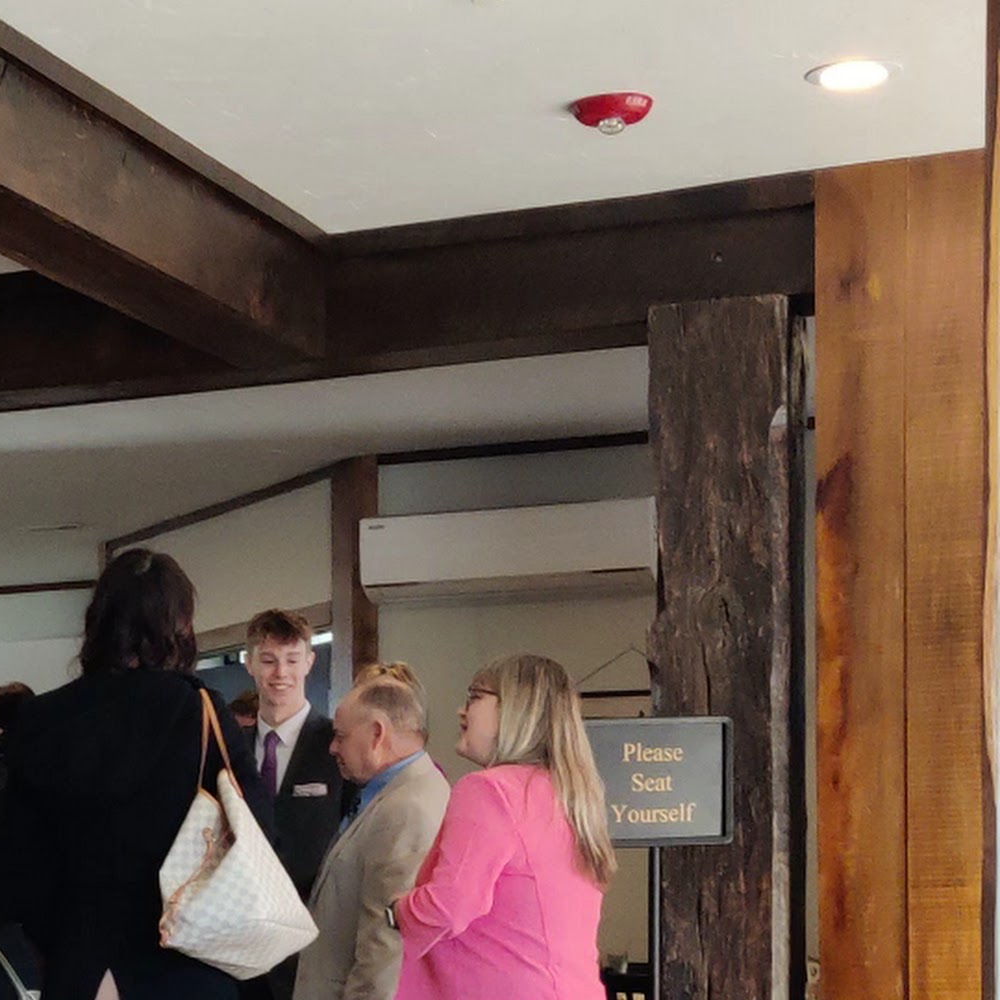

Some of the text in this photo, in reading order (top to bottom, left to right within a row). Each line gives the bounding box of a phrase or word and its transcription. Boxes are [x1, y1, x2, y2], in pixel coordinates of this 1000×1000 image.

[622, 742, 684, 762] Please
[631, 773, 673, 792] Seat
[611, 802, 697, 823] Yourself
